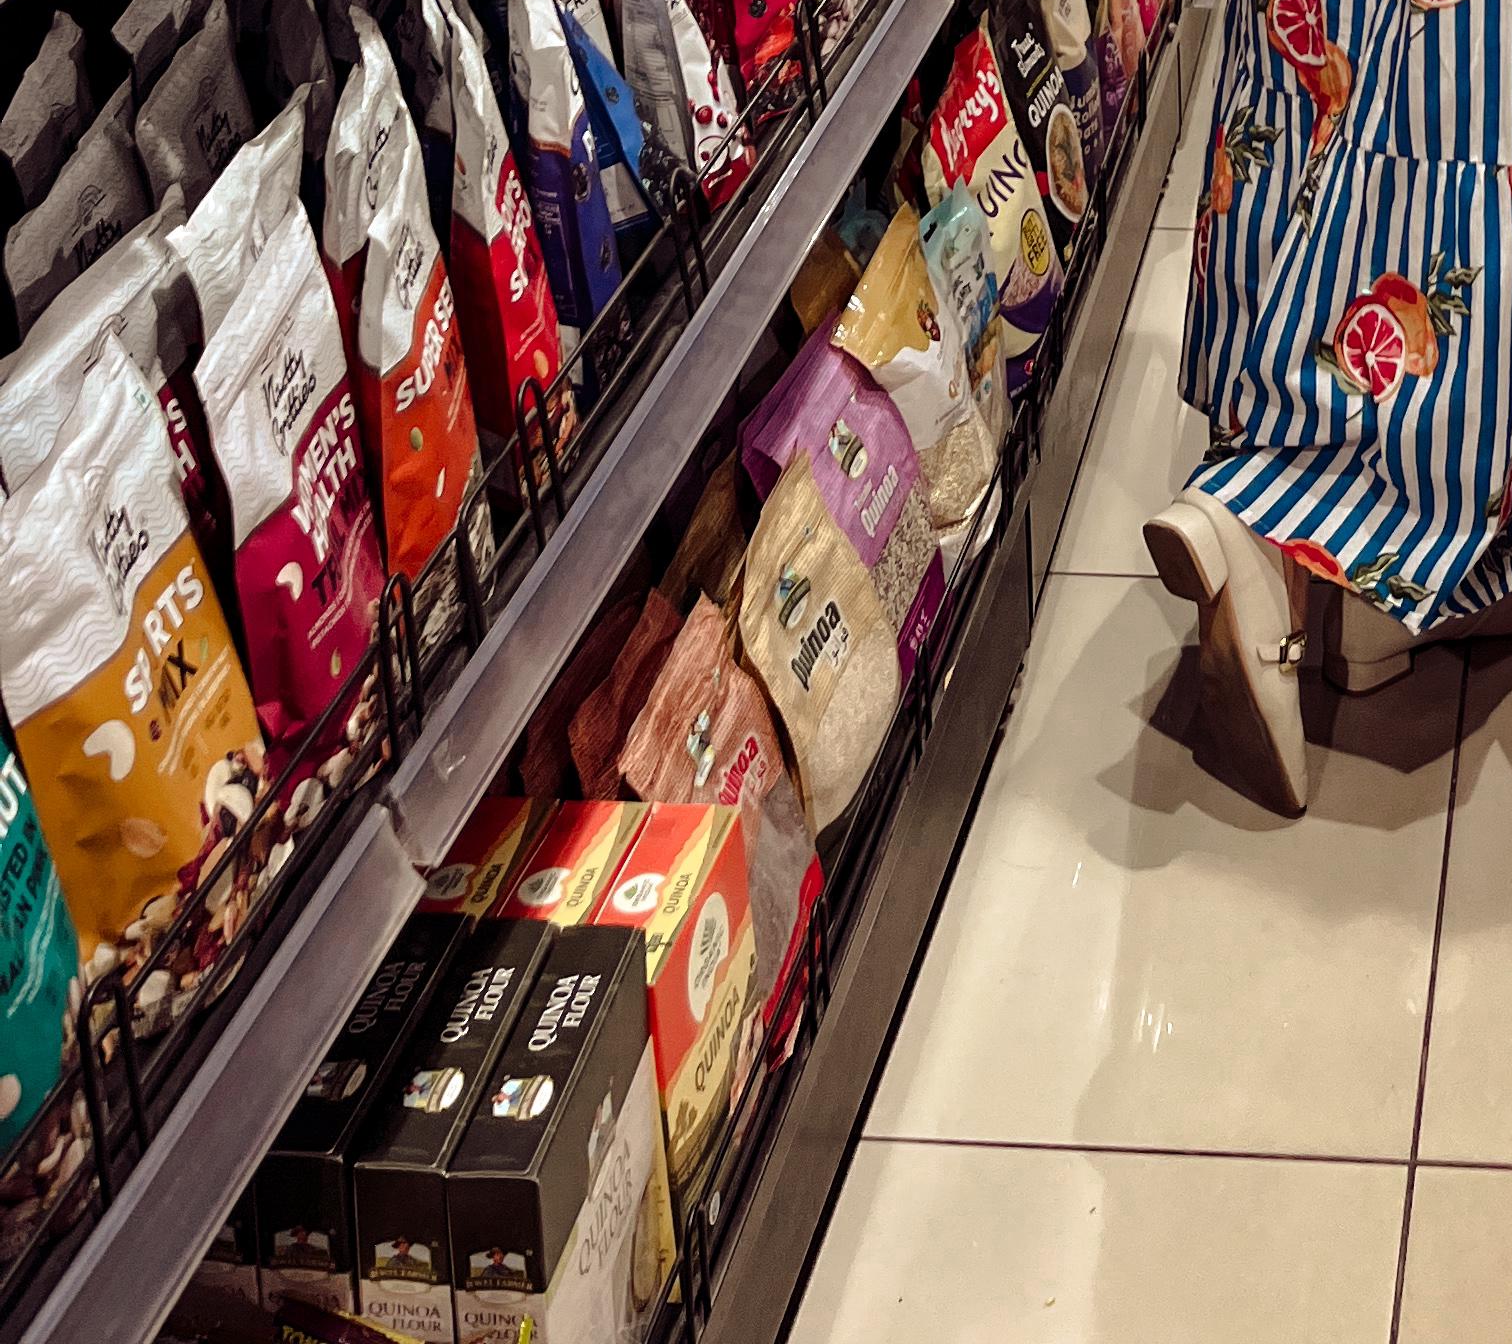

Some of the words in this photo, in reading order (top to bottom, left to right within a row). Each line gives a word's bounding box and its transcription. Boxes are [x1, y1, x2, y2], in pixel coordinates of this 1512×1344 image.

[1027, 64, 1065, 129] QUINOA
[976, 138, 1028, 219] UINO
[291, 392, 356, 534] WMEN'S
[124, 565, 204, 715] SRTS
[790, 600, 841, 693] Quinoa
[470, 862, 505, 905] QUINOA
[565, 866, 600, 908] QUINOA
[662, 872, 694, 915] QUINOA
[439, 966, 495, 1044] QUINOA
[474, 966, 516, 1023] FLOUR
[527, 973, 581, 1052] QUINOA
[561, 973, 602, 1029] FLOUR
[368, 1299, 441, 1320] QUINOA
[392, 1316, 442, 1334] FLOUR
